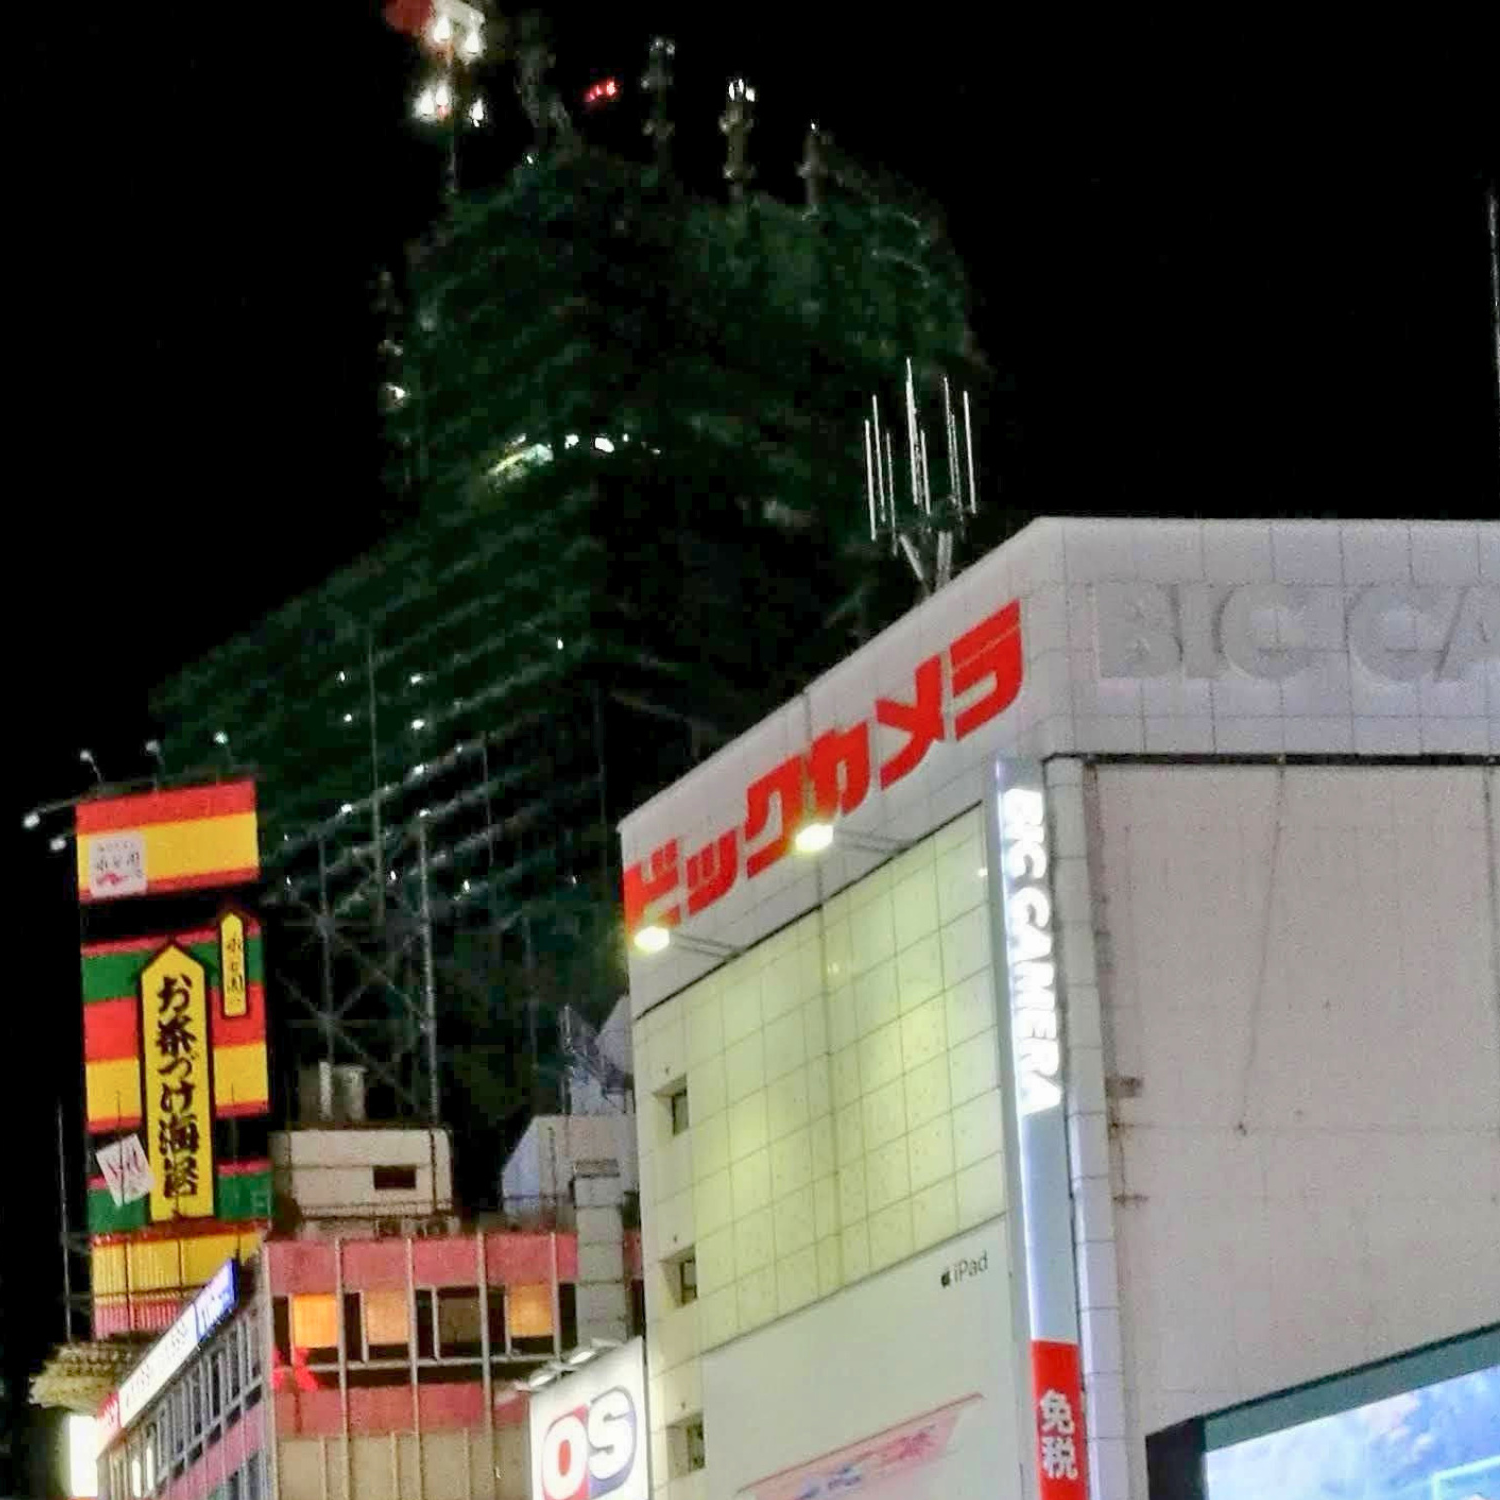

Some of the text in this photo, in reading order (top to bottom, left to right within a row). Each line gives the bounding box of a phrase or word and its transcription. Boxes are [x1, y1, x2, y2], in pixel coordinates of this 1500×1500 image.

[624, 600, 1023, 946] ビックカメラ
[155, 974, 200, 1198] お茶づけ海苔
[1008, 886, 1063, 1115] CAMERA
[954, 1250, 988, 1282] iPad
